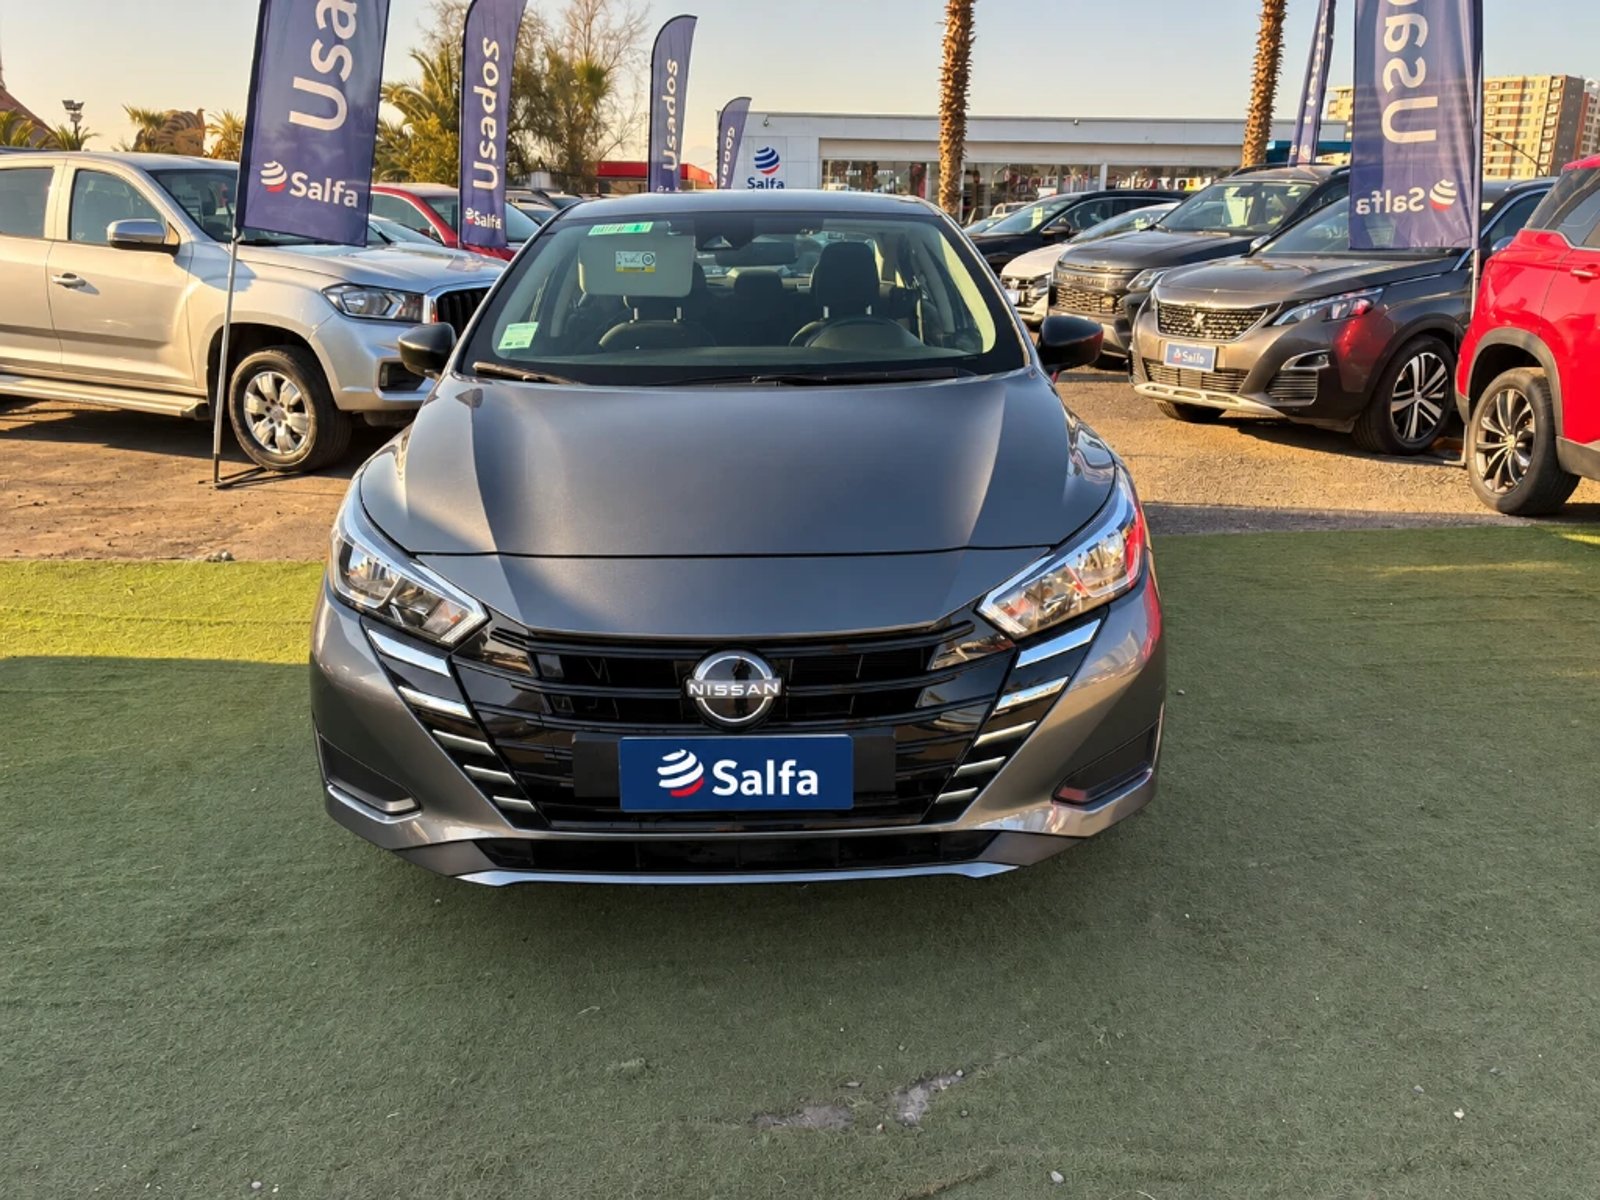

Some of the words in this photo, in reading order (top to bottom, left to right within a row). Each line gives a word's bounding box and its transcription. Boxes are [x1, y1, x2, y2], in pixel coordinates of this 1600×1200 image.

[472, 36, 500, 191] Usados
[661, 58, 679, 171] Usados
[289, 170, 359, 208] Salfa
[747, 176, 785, 189] Salfa
[474, 209, 503, 230] Salfa
[688, 682, 781, 697] NISSAN
[712, 759, 819, 797] Salfa
